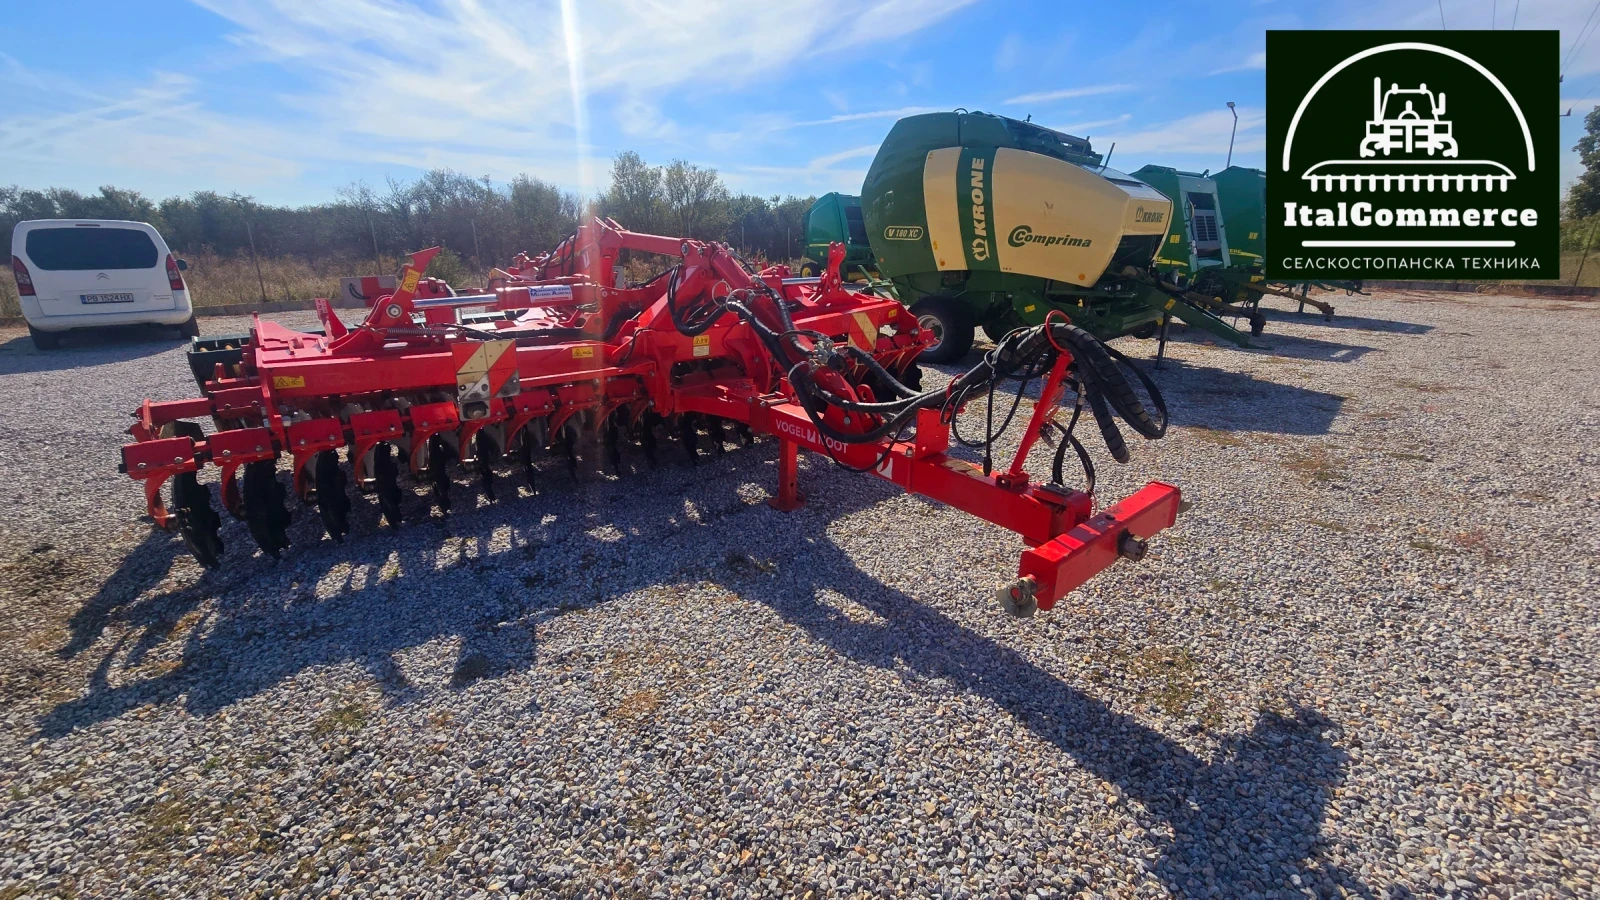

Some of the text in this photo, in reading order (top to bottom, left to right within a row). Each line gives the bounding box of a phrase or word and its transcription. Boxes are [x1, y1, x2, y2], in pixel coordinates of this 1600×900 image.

[971, 158, 987, 237] KRONE
[1142, 211, 1164, 223] KRONE
[888, 228, 919, 238] V 180 XC
[1007, 225, 1092, 248] Comprima
[100, 294, 119, 302] 1524
[775, 418, 806, 439] VOGEL
